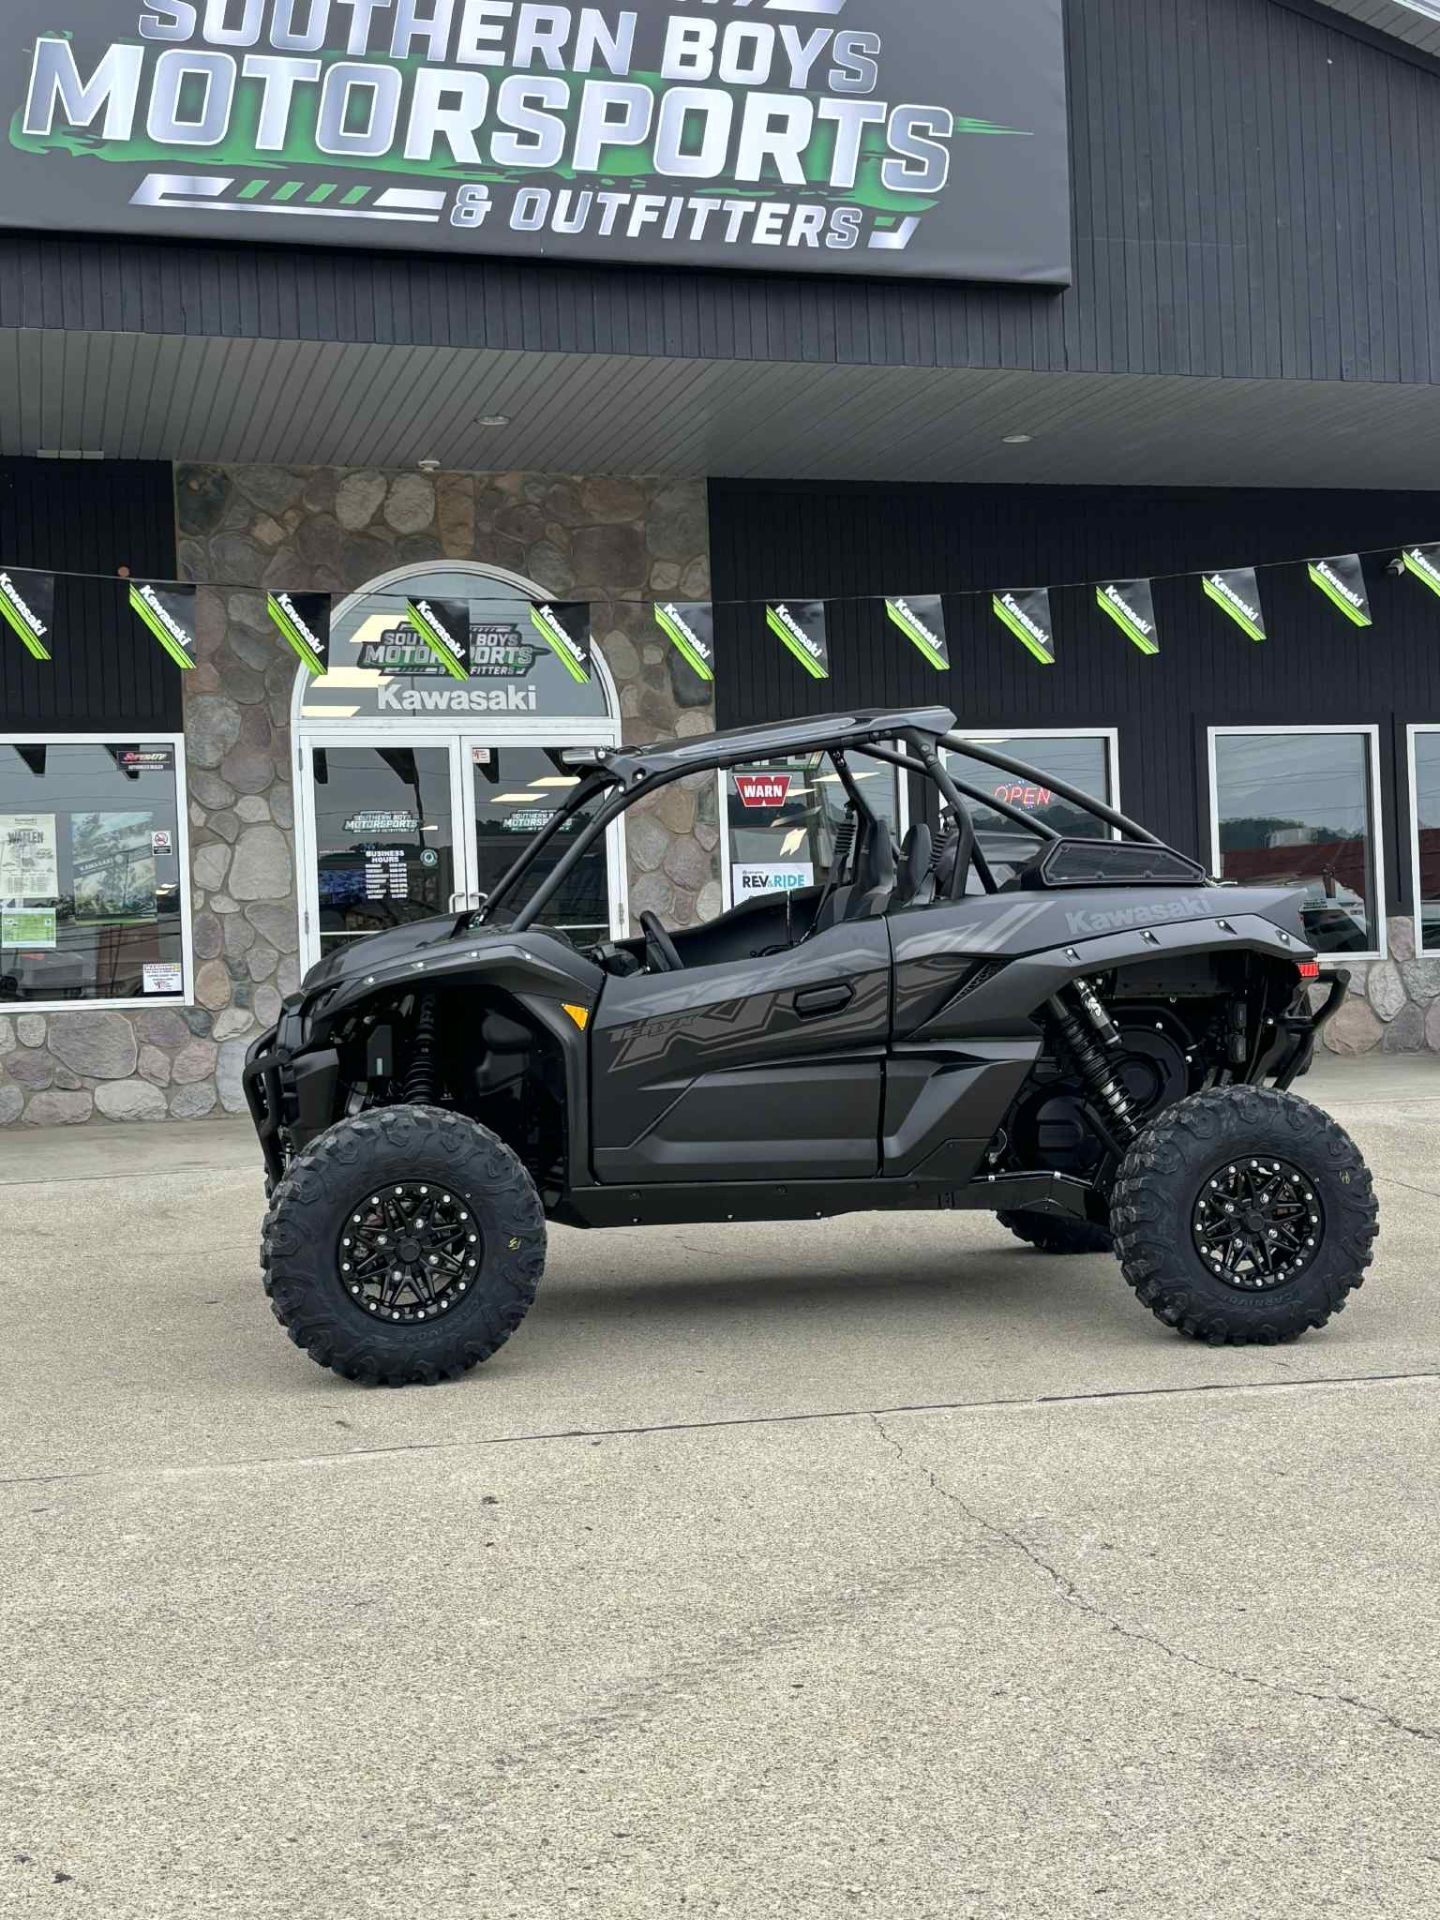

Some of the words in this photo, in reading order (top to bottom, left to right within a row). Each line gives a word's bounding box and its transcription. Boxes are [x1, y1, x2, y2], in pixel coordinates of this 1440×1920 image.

[138, 0, 638, 75] SOUTHERN
[661, 15, 881, 94] BOYS
[22, 37, 955, 193] MOTORSPORTS
[450, 184, 492, 228] &
[510, 187, 863, 250] OUTFITTERS
[0, 572, 48, 637] Kawasaki
[1104, 585, 1152, 636] Kawasaki
[1210, 574, 1259, 622] Kawasaki
[1316, 561, 1364, 608] Kawasaki
[139, 584, 192, 648] Kawasaki
[277, 593, 326, 655] Kawasaki
[415, 600, 467, 660] Kawasaki
[476, 633, 518, 646] BOYS
[539, 604, 587, 662] Kawasaki
[663, 603, 711, 659] Kawasaki
[775, 604, 823, 658] Kawasaki
[894, 599, 943, 650] Kawasaki
[1001, 593, 1049, 645] Kawasaki
[377, 684, 537, 711] Kawasaki
[743, 785, 783, 798] WARN
[993, 785, 1051, 806] OPEN
[345, 820, 418, 830] MOTORSPORTS
[1064, 894, 1213, 935] Kawasaki
